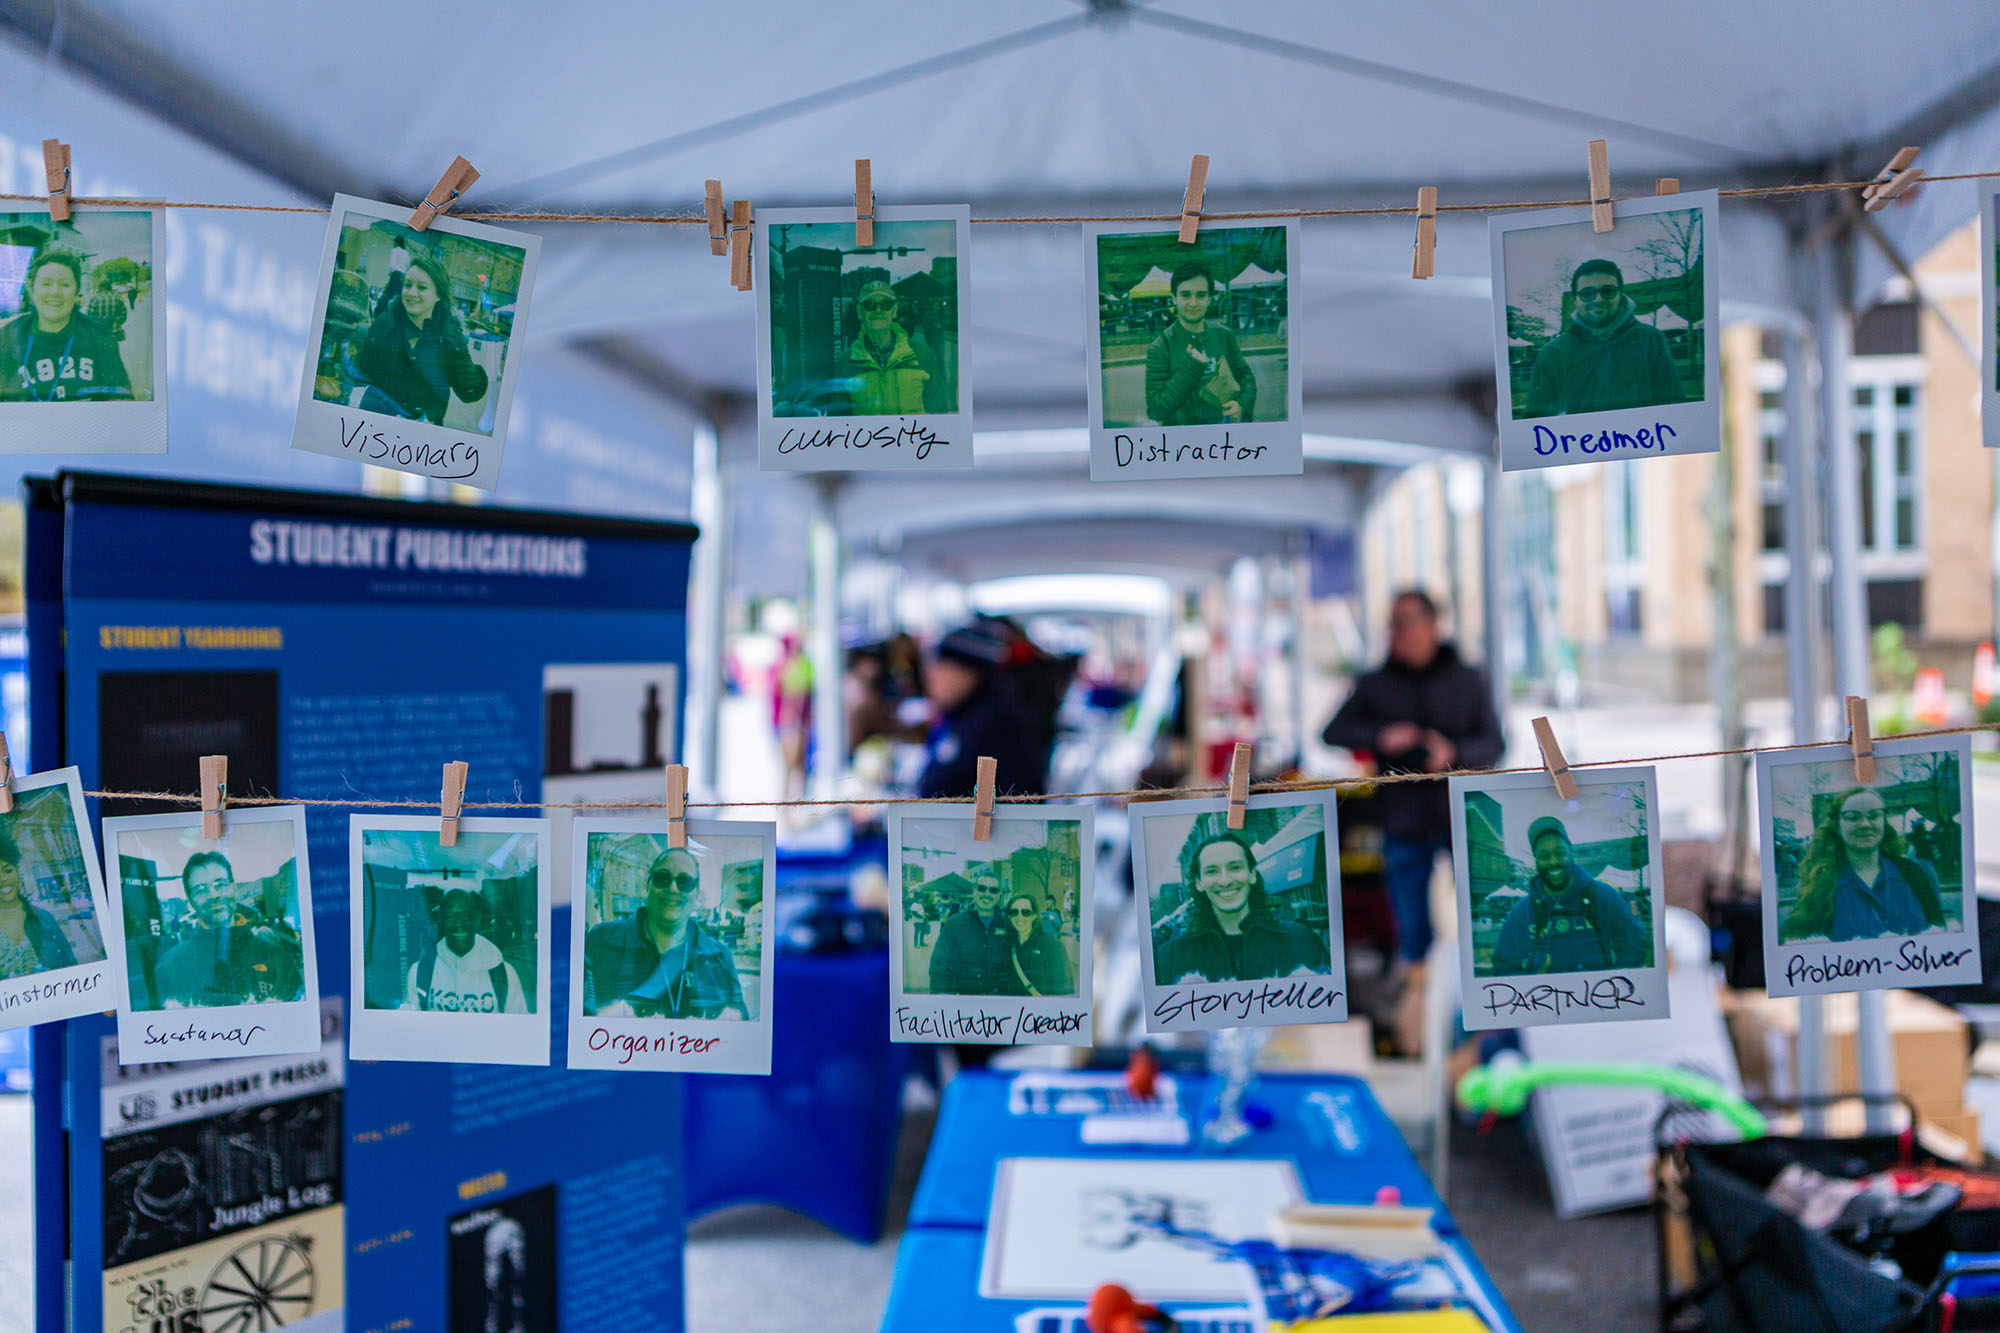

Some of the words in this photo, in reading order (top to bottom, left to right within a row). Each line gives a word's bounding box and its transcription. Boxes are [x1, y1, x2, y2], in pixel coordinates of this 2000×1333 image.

[17, 356, 94, 389] 1925
[341, 417, 479, 479] Visionary
[1115, 431, 1268, 467] Distractor
[1533, 422, 1677, 456] Dreamer
[250, 519, 393, 569] STUDENT
[394, 527, 588, 579] PUBLICATIONS
[0, 973, 102, 1012] instormer
[1154, 981, 1344, 1025] Storyteller
[588, 1028, 721, 1064] Organizer
[170, 1073, 264, 1110] STUDENT
[269, 1058, 329, 1087] PRESS
[208, 1194, 283, 1232] Jungle
[287, 1182, 334, 1209] Log
